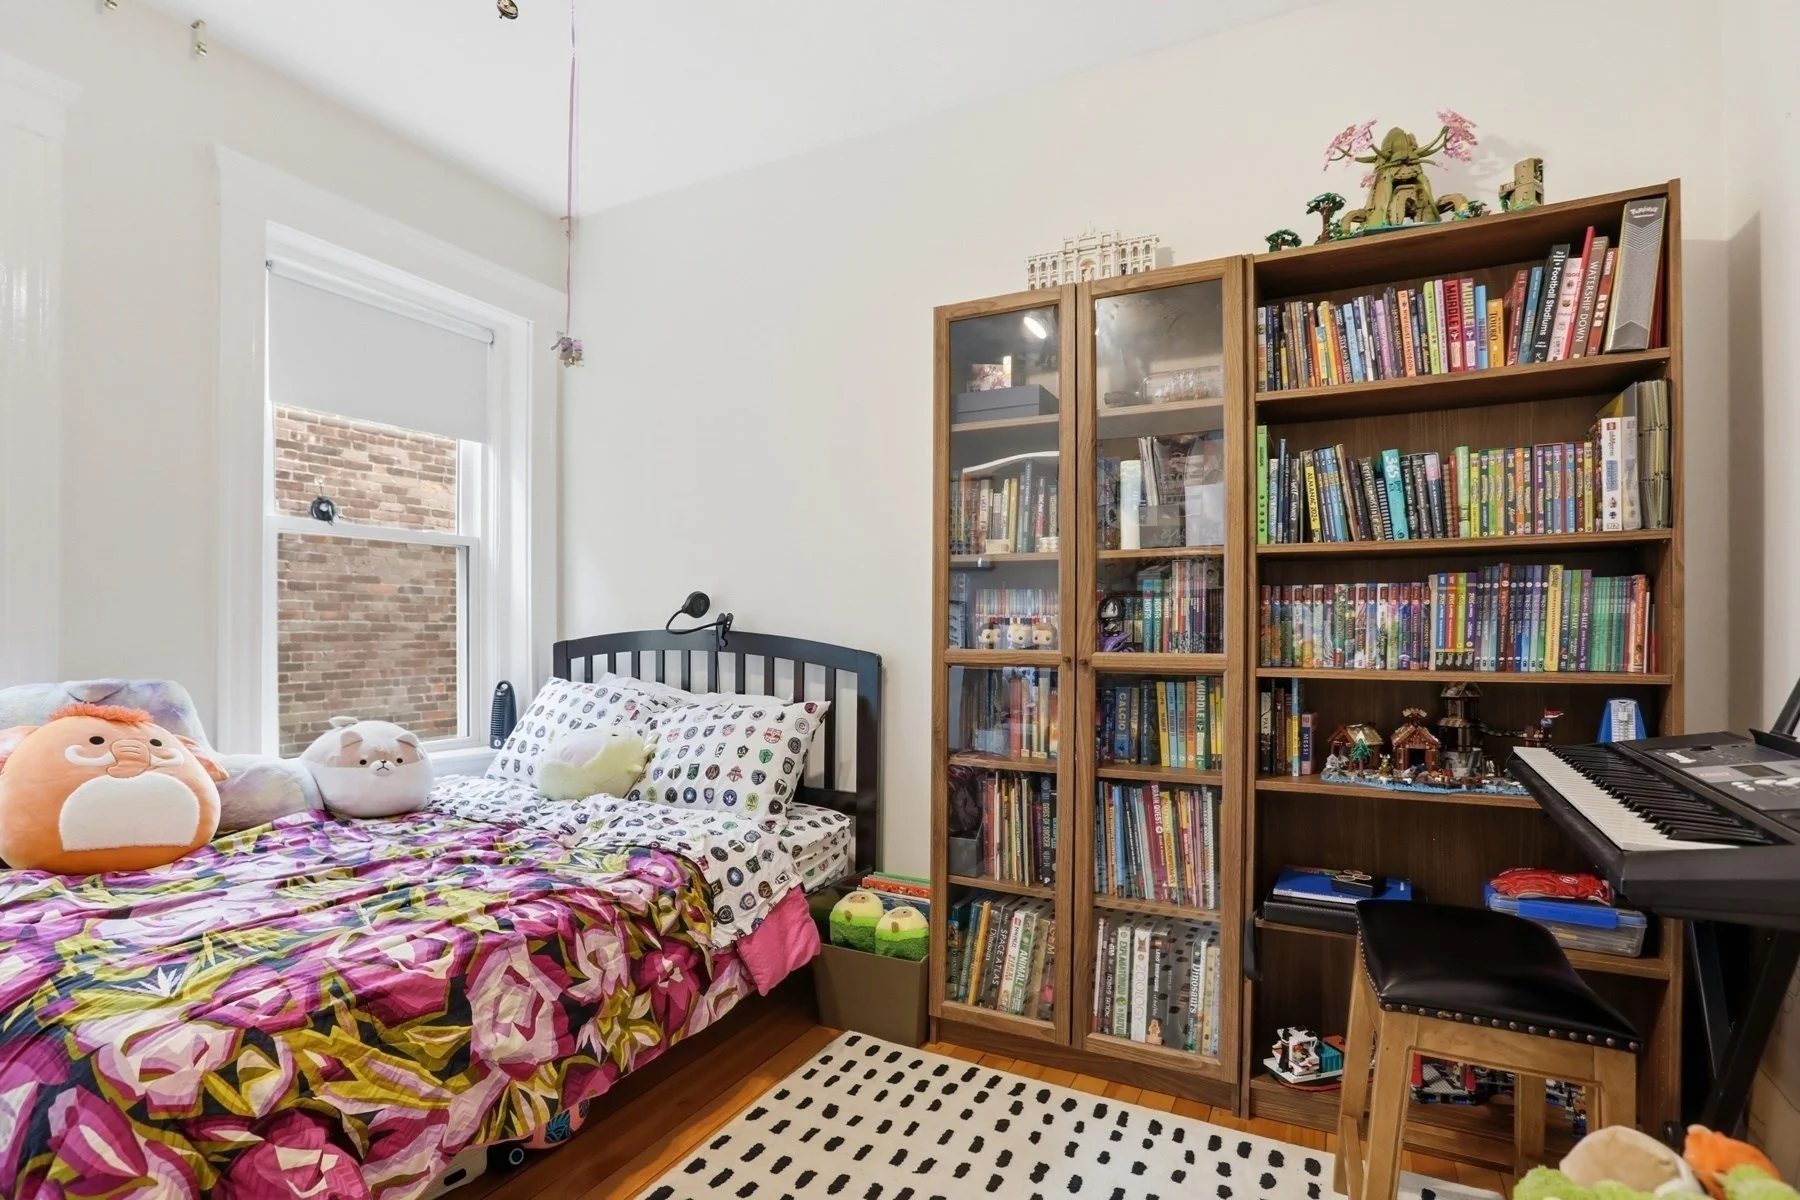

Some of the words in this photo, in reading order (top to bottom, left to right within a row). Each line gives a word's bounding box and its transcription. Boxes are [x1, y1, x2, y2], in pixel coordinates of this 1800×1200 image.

[1547, 266, 1561, 298] Football
[1582, 260, 1599, 311] WATERSHIP
[1446, 284, 1459, 328] MURDLE
[1461, 281, 1474, 326] MURDLE
[1539, 299, 1554, 336] Stadiums
[1489, 312, 1498, 341] TOTORO
[1575, 313, 1589, 342] DOWN
[1385, 455, 1399, 479] 365
[1307, 472, 1316, 506] ALMANAC
[1310, 507, 1318, 522] 2024
[1118, 692, 1127, 730] CALCIO
[1196, 680, 1205, 718] MURDLE
[1042, 802, 1050, 818] GODS
[1151, 785, 1161, 804] BRAIN
[1153, 804, 1162, 825] QUEST
[1043, 826, 1051, 847] SOCCER
[996, 928, 1008, 955] SPACE
[992, 957, 1002, 985] ATLAS
[1016, 949, 1028, 985] ANIMAL!
[1118, 941, 1128, 995] EXPLANATORIUM
[1134, 964, 1145, 1022] ZOOLOGY
[1189, 963, 1201, 1014] Dinosaurs
[1116, 1012, 1125, 1038] NATUR
